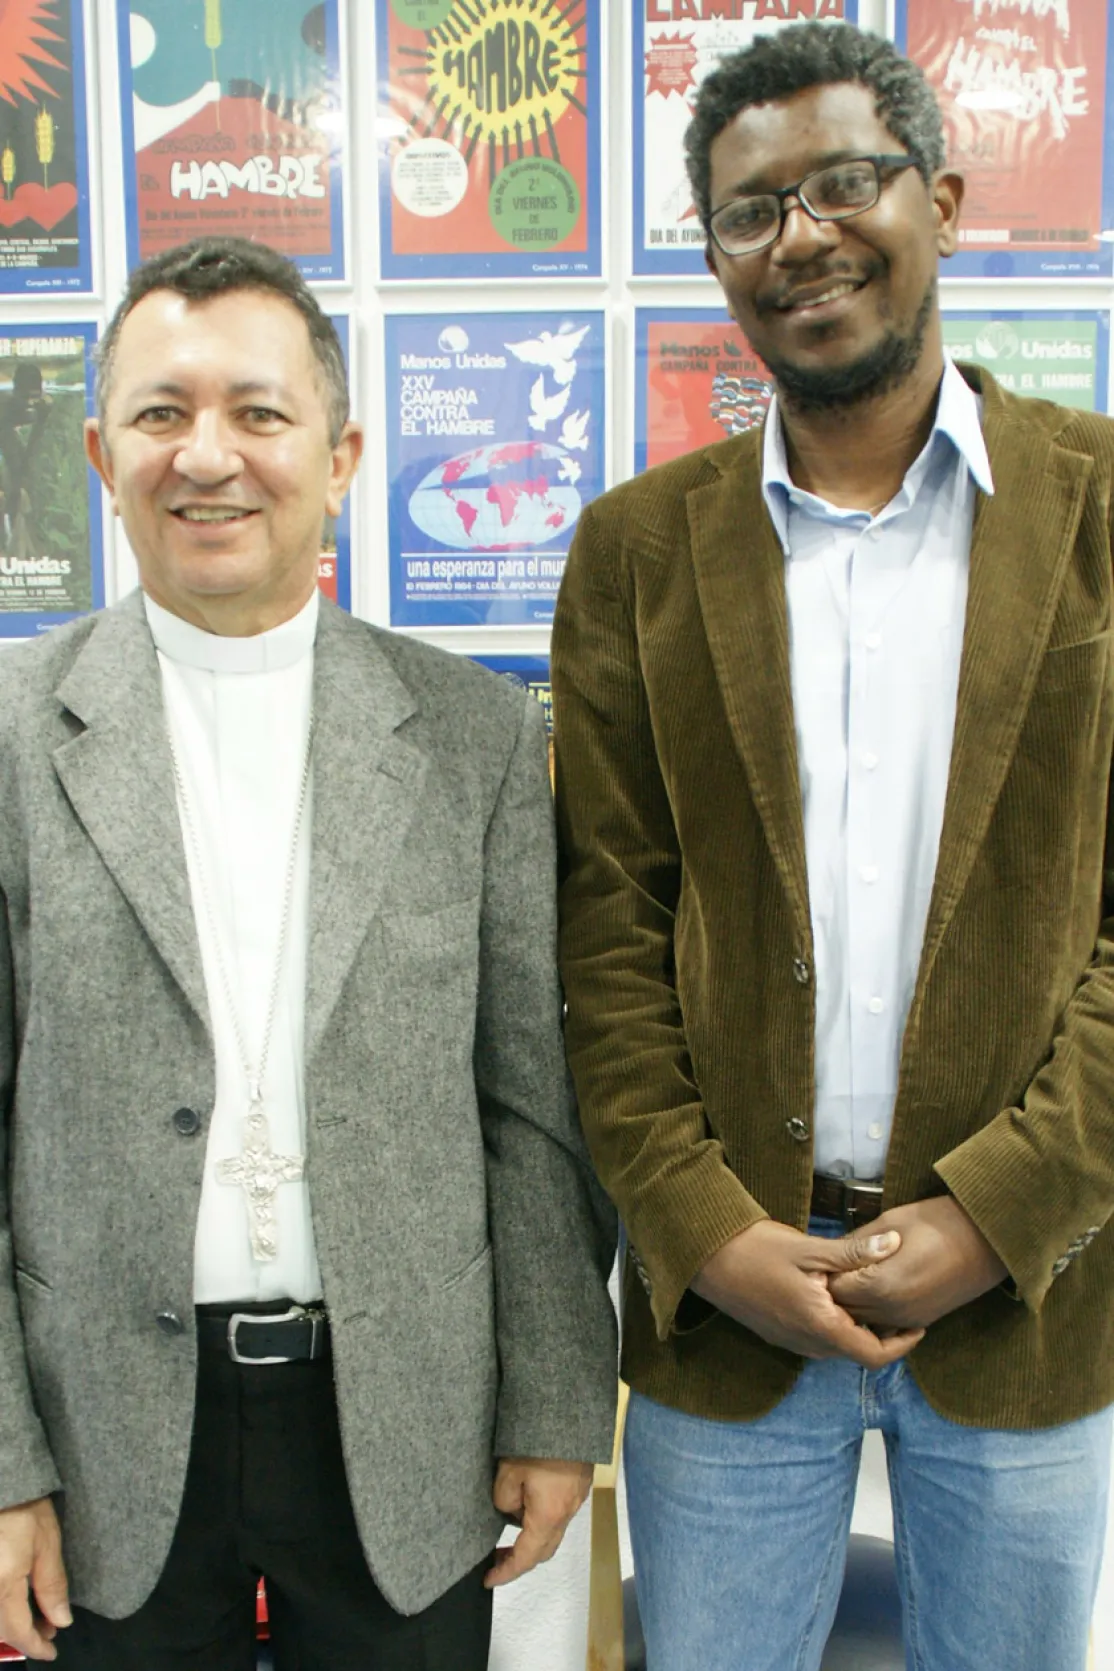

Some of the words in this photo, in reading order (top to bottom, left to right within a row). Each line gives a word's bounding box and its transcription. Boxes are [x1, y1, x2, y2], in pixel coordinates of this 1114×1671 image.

[442, 17, 562, 115] HAMBRE
[943, 36, 1090, 140] HAMBRE
[170, 154, 327, 200] HAMBRE
[512, 196, 558, 211] VIERNES
[529, 213, 540, 224] DE
[512, 228, 558, 242] FEBRERO
[660, 342, 721, 357] Manos
[1021, 340, 1093, 359] Unidas
[400, 353, 452, 370] Manos
[455, 352, 507, 369] Unidas
[716, 359, 758, 372] CONTRA
[402, 374, 434, 390] XXV
[1021, 374, 1035, 388] EL
[1042, 373, 1093, 388] HAMBRE
[401, 386, 478, 405] CAMPAÑA
[401, 404, 470, 420] CONTRA
[402, 420, 422, 435] EL
[426, 419, 496, 435] HAMBRE
[0, 556, 71, 575] Unidas
[407, 560, 430, 578] una
[432, 560, 495, 583] esperanza
[497, 560, 525, 581] para
[528, 556, 539, 577] el
